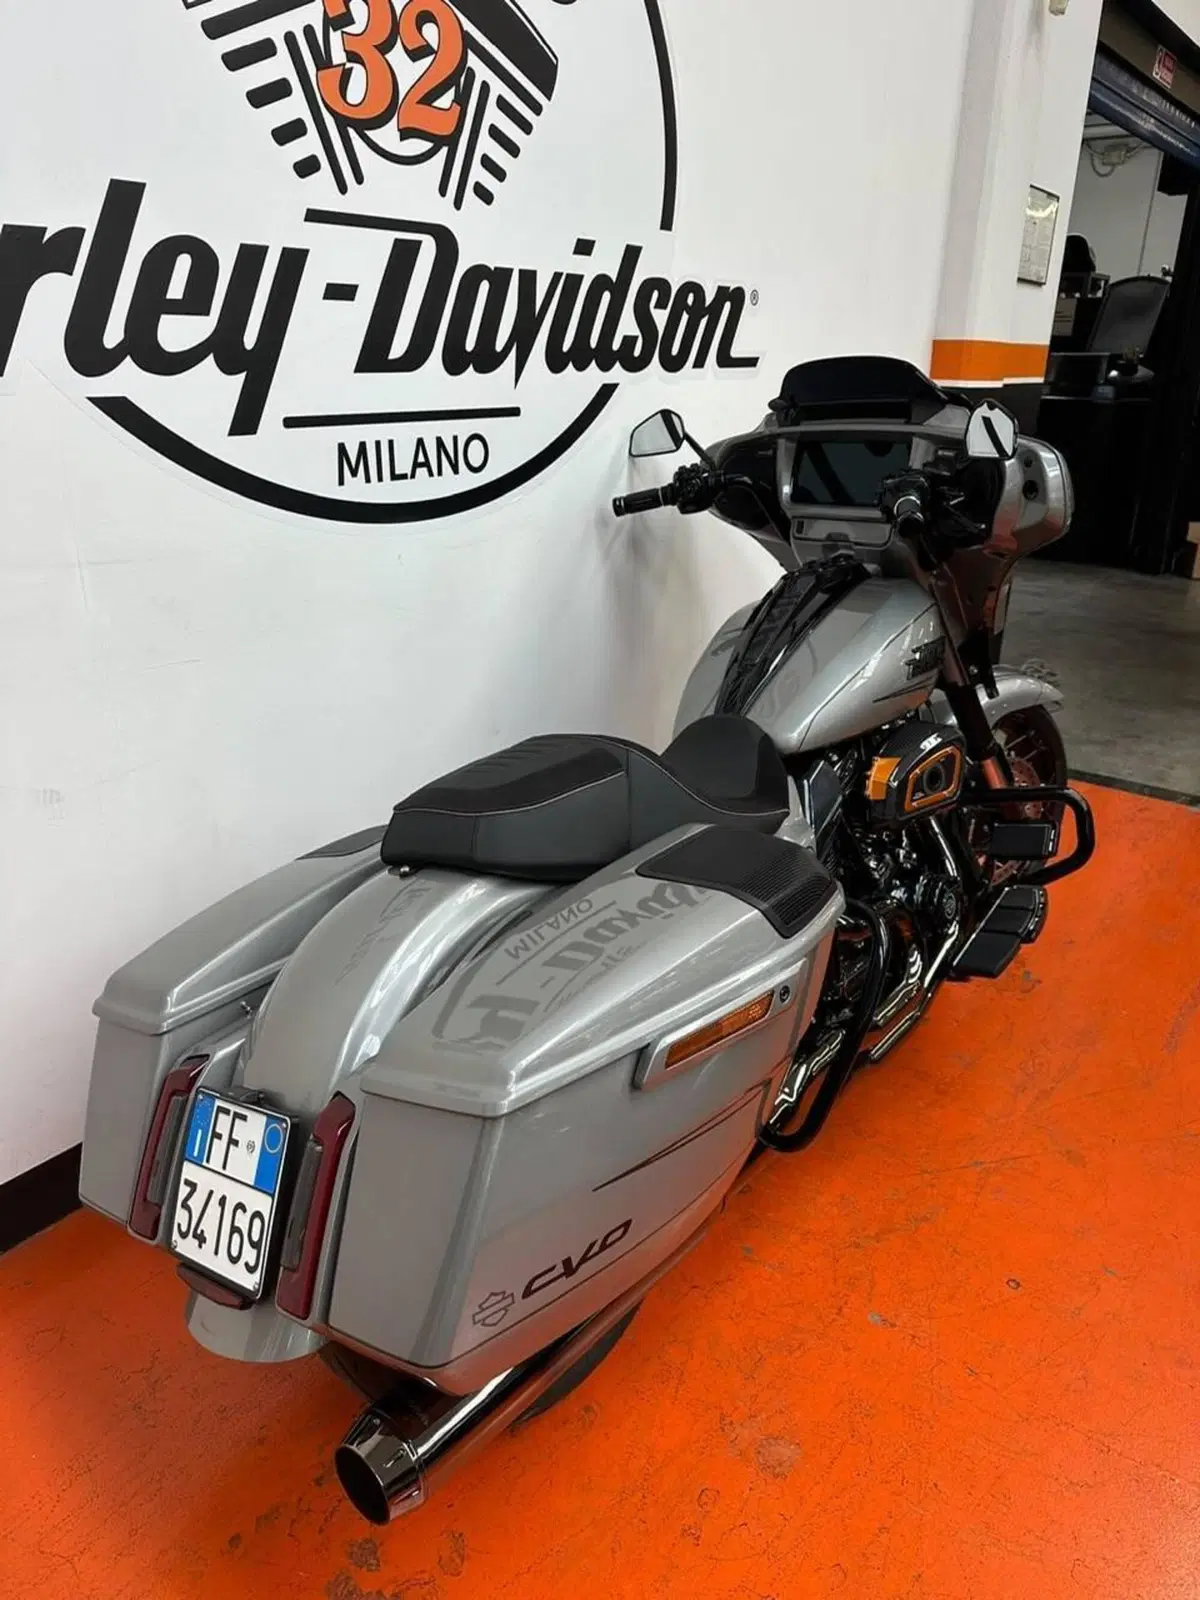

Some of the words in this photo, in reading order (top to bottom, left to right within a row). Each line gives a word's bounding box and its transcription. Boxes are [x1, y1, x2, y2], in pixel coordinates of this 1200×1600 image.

[315, 0, 467, 144] 32
[337, 433, 490, 486] MILANO
[205, 1104, 248, 1171] FF
[176, 1177, 266, 1275] 34169
[521, 1218, 633, 1300] CVO
